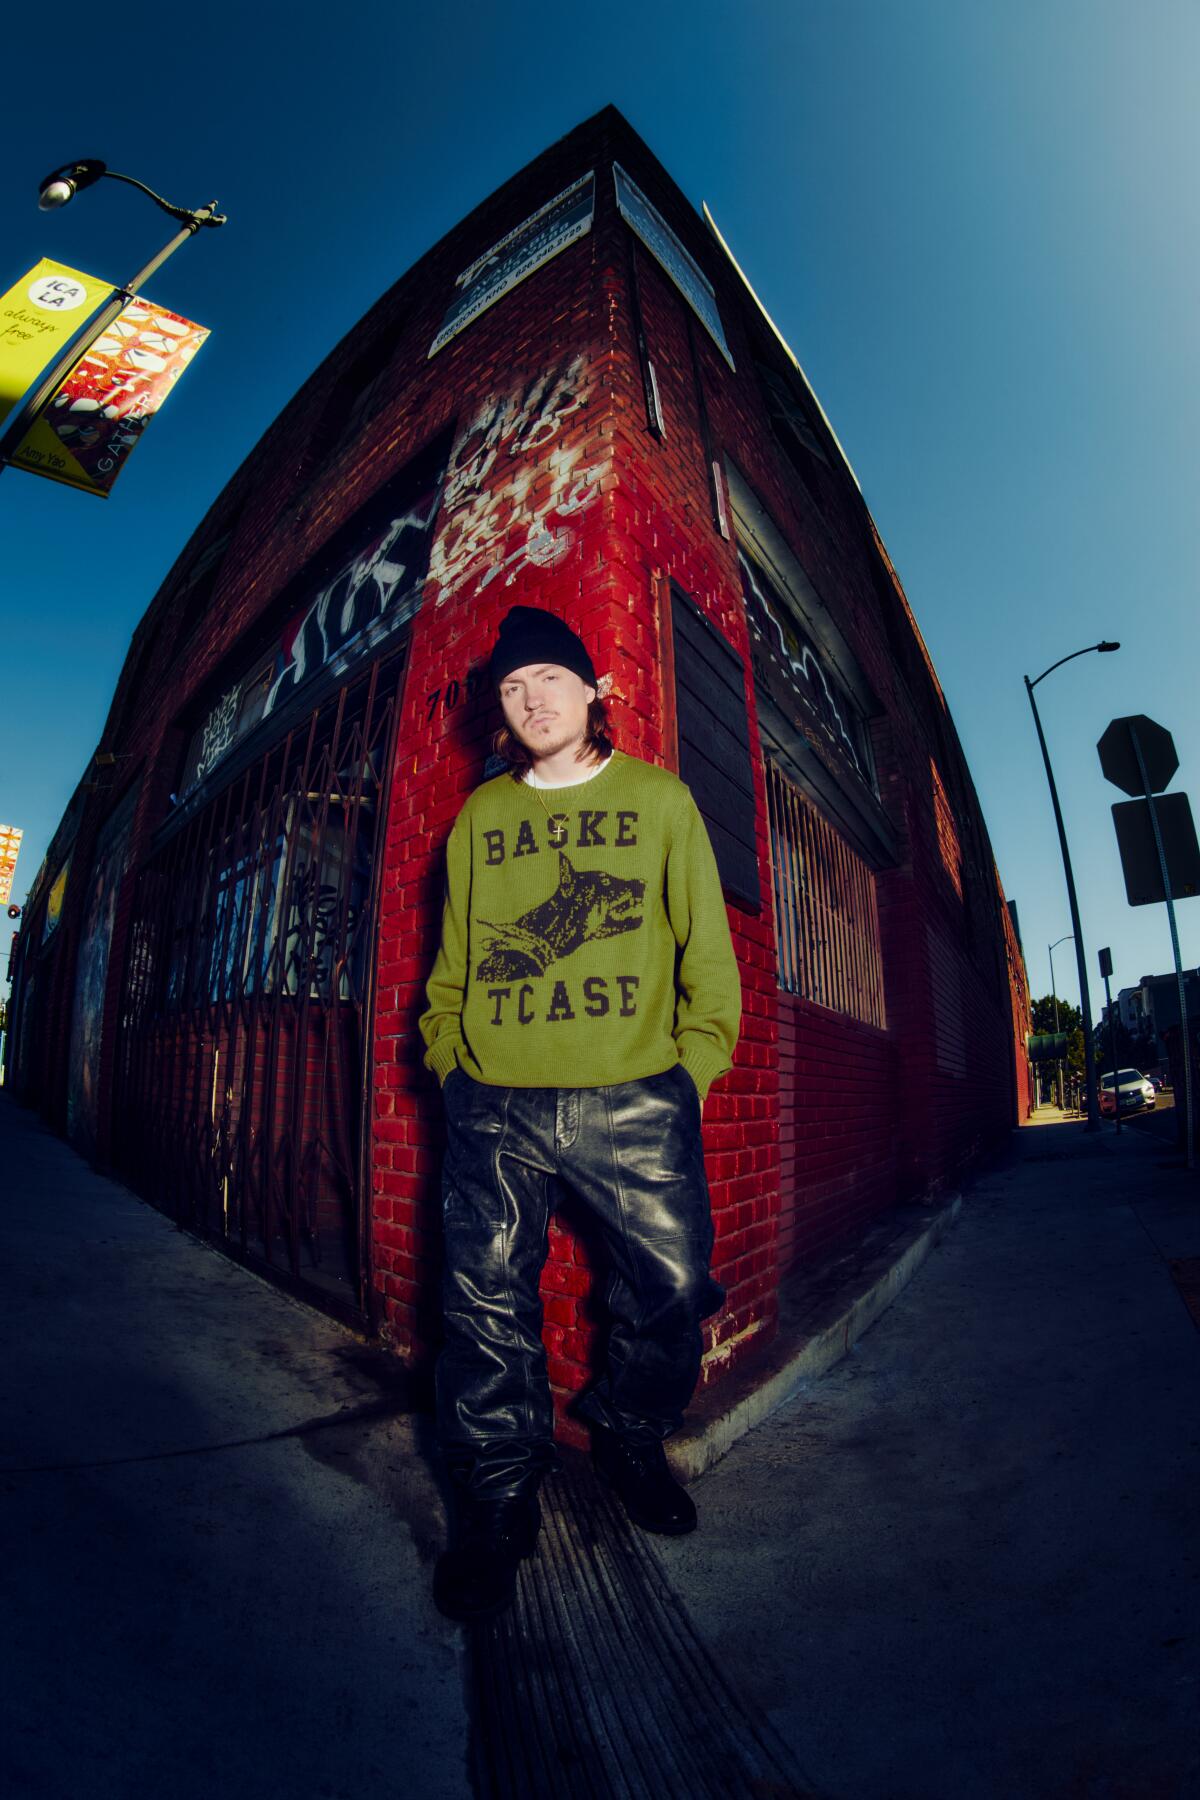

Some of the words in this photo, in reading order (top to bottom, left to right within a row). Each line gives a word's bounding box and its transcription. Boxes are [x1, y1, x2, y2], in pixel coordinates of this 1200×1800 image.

[38, 291, 65, 307] LA
[46, 280, 79, 297] ICA
[485, 280, 508, 303] KHO
[0, 323, 34, 340] free
[4, 309, 59, 333] always
[20, 446, 46, 462] Amy
[47, 452, 66, 468] Yao
[483, 810, 638, 865] BASKE
[488, 975, 640, 1025] TCASE
